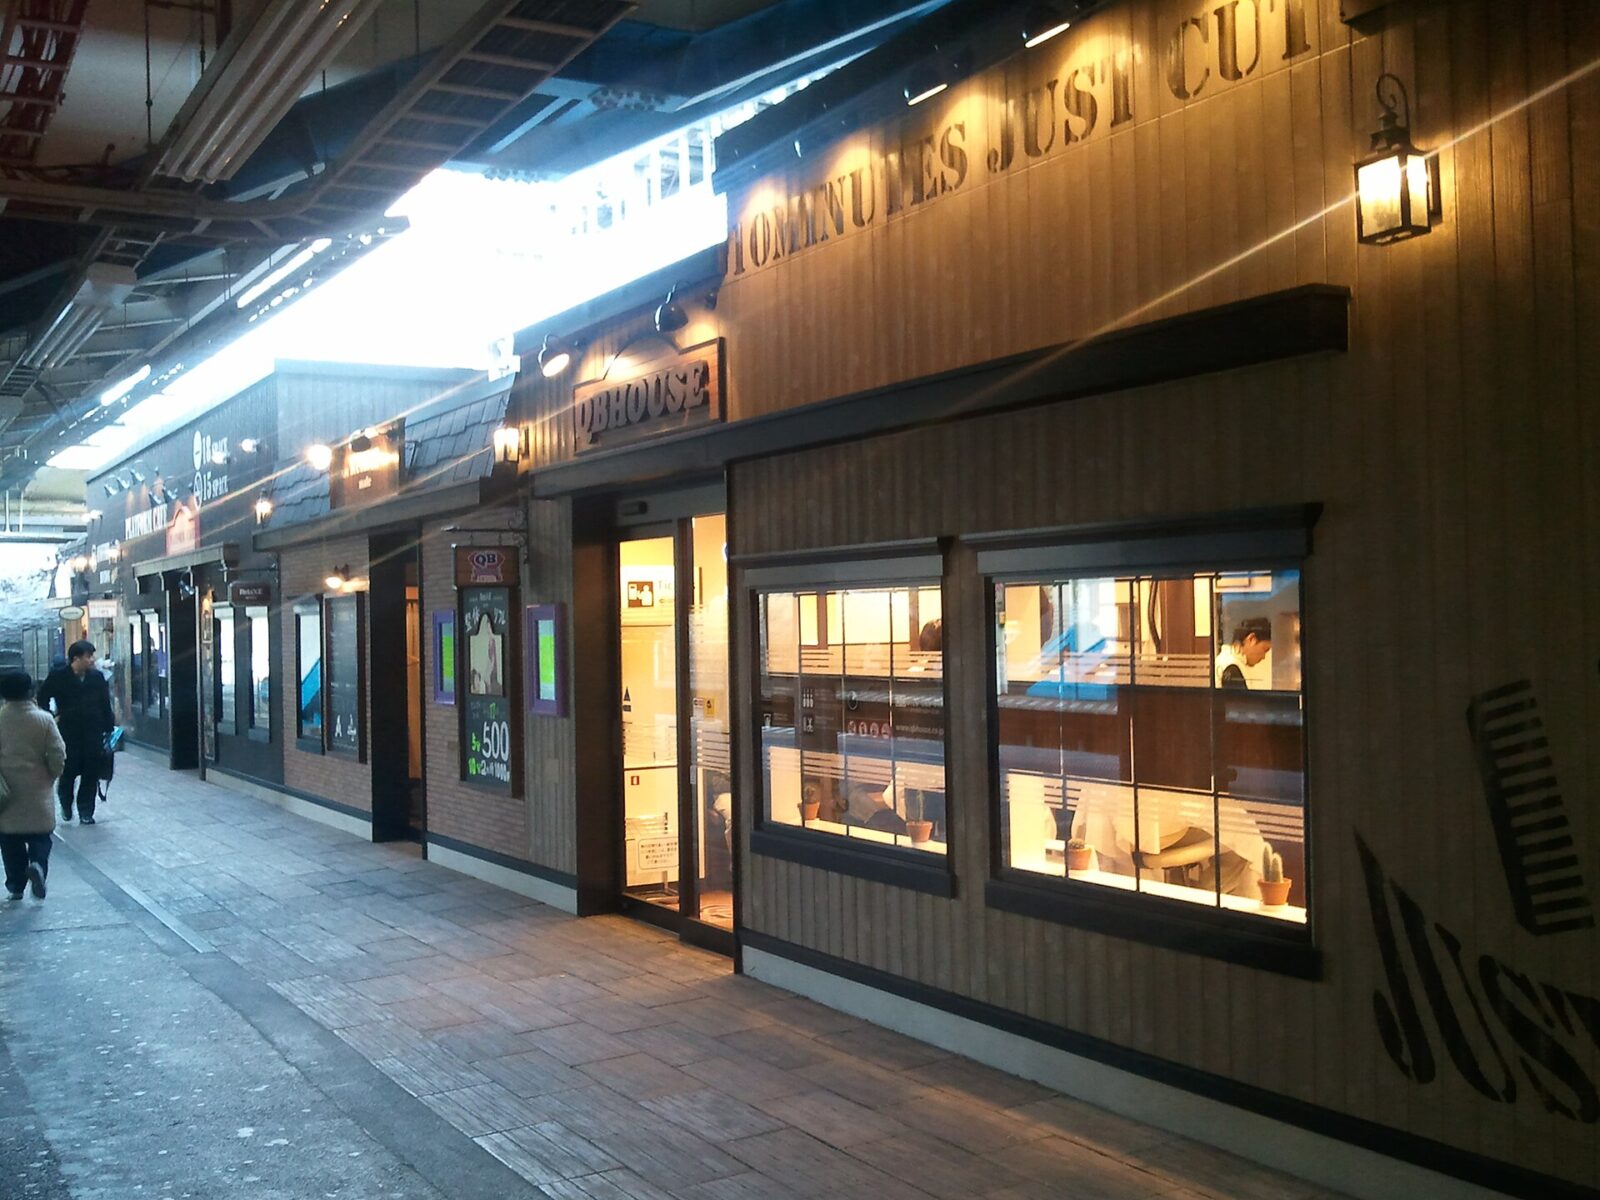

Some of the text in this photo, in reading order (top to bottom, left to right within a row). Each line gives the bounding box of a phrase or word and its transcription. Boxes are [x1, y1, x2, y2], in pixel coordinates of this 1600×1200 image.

[986, 46, 1133, 174] JUST
[1166, 0, 1312, 101] CUT
[574, 360, 709, 443] QBHOUSE
[475, 553, 497, 567] QB
[482, 721, 510, 762] 500
